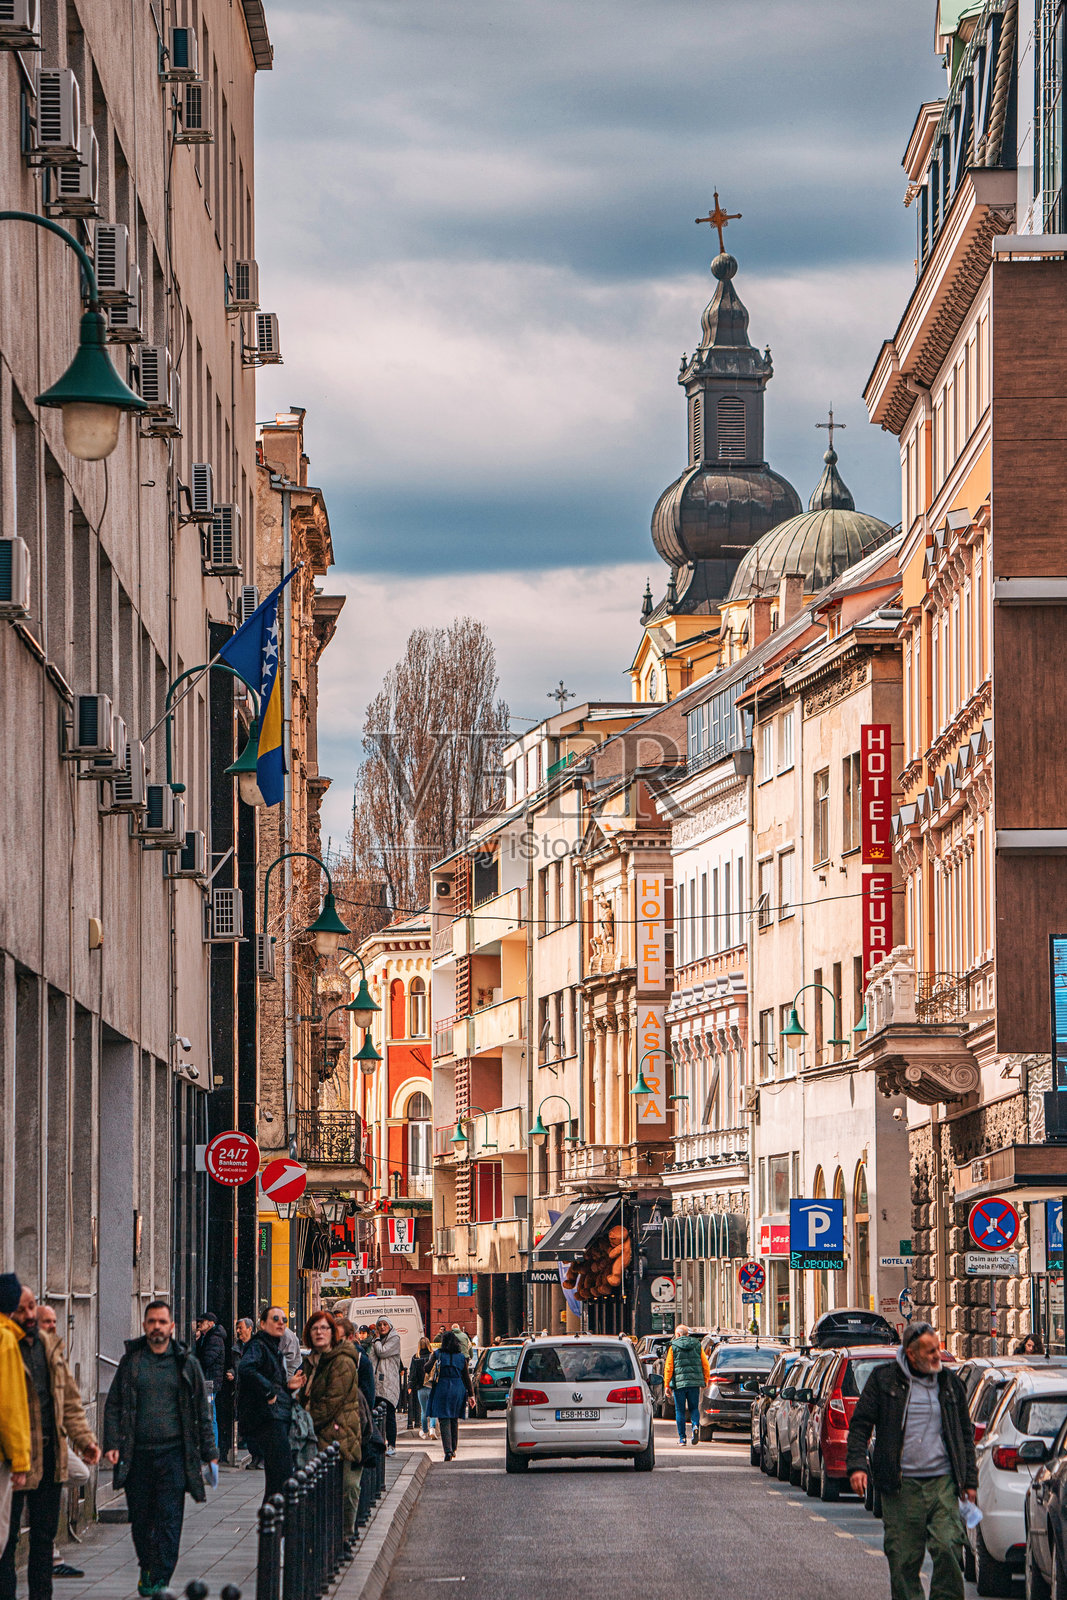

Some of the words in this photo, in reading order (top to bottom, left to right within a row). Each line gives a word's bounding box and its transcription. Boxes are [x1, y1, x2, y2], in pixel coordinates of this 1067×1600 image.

[867, 729, 885, 845] HOTEL
[641, 879, 661, 984] HOTEL
[641, 1011, 662, 1118] ASTRA
[219, 1148, 248, 1160] 24/7
[808, 1211, 831, 1247] P
[393, 1244, 410, 1252] KFC
[790, 1260, 844, 1269] SLOBODNO
[531, 1273, 559, 1281] MONA
[356, 1308, 384, 1316] DELIVERING
[560, 1410, 599, 1419] E58-M-838
